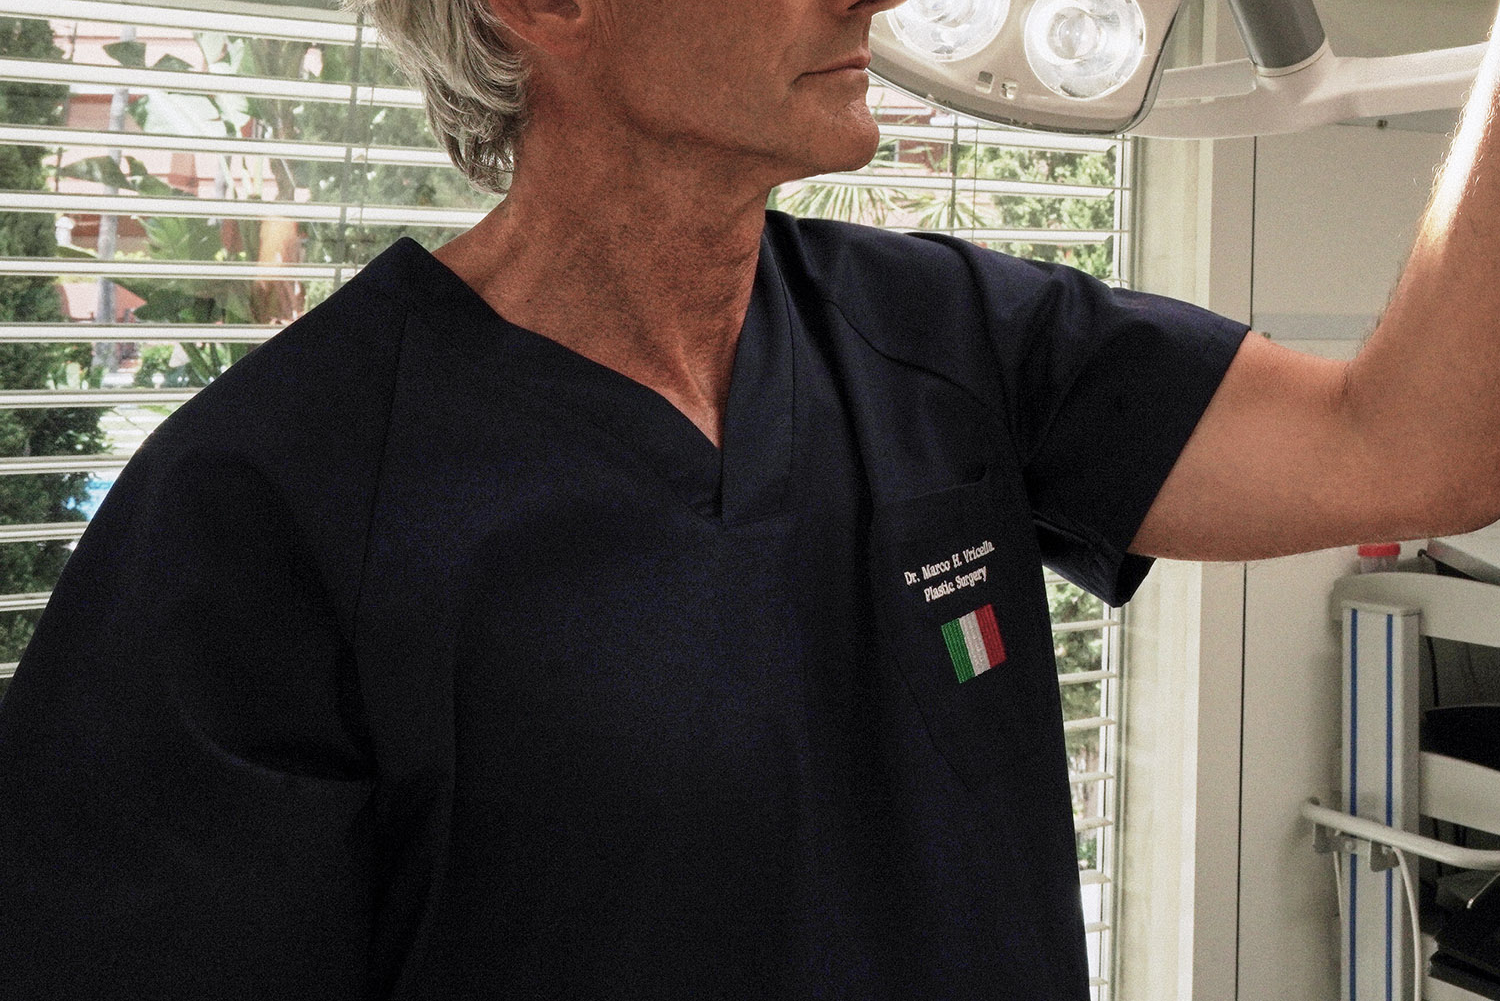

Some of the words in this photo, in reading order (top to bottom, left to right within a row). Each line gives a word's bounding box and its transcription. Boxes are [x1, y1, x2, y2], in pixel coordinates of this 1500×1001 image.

[904, 571, 921, 586] Dr.
[921, 559, 951, 580] Marco
[952, 554, 963, 569] H.
[962, 540, 995, 563] Vricella
[924, 582, 955, 602] Plastic
[956, 565, 988, 589] Surgery
